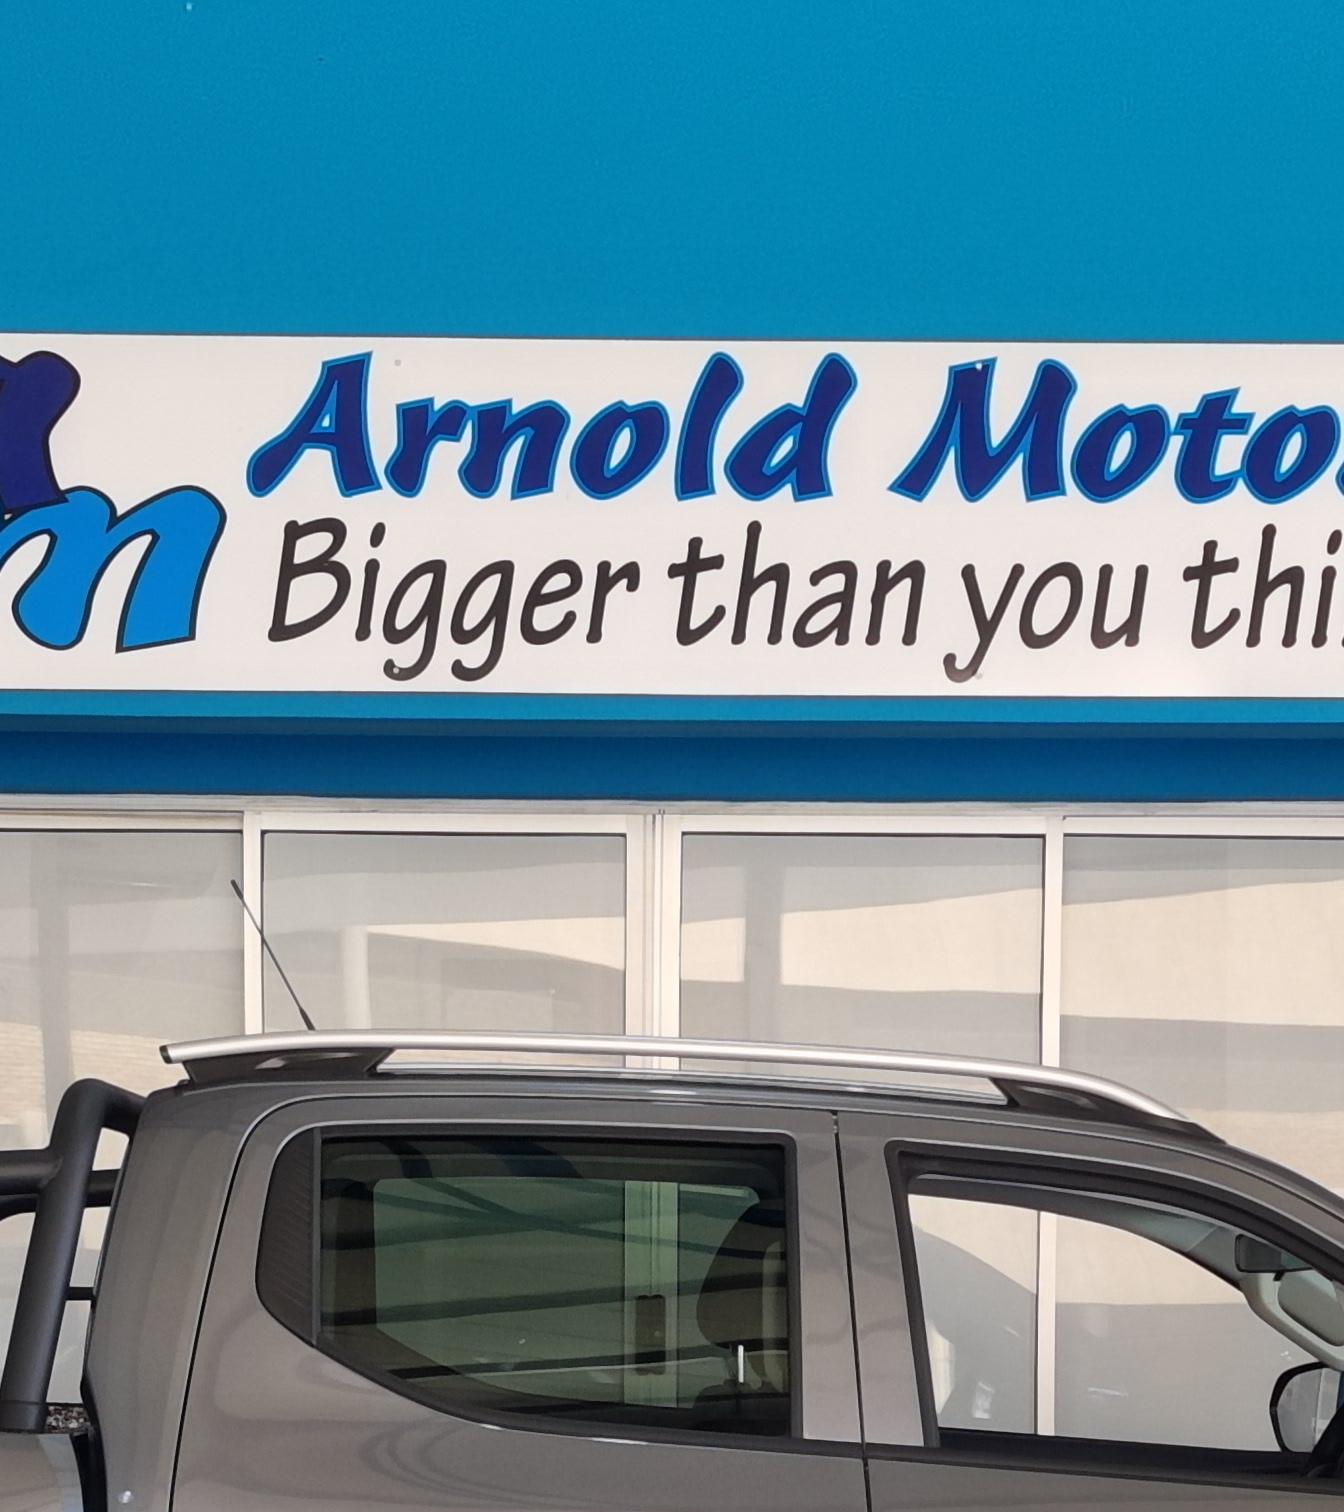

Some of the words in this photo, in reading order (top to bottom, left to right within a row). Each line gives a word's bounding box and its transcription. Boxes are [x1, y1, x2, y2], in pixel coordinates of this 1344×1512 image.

[246, 350, 857, 502] Arnold
[267, 516, 640, 682] Bigger
[667, 520, 926, 650] than
[943, 560, 1150, 684] you
